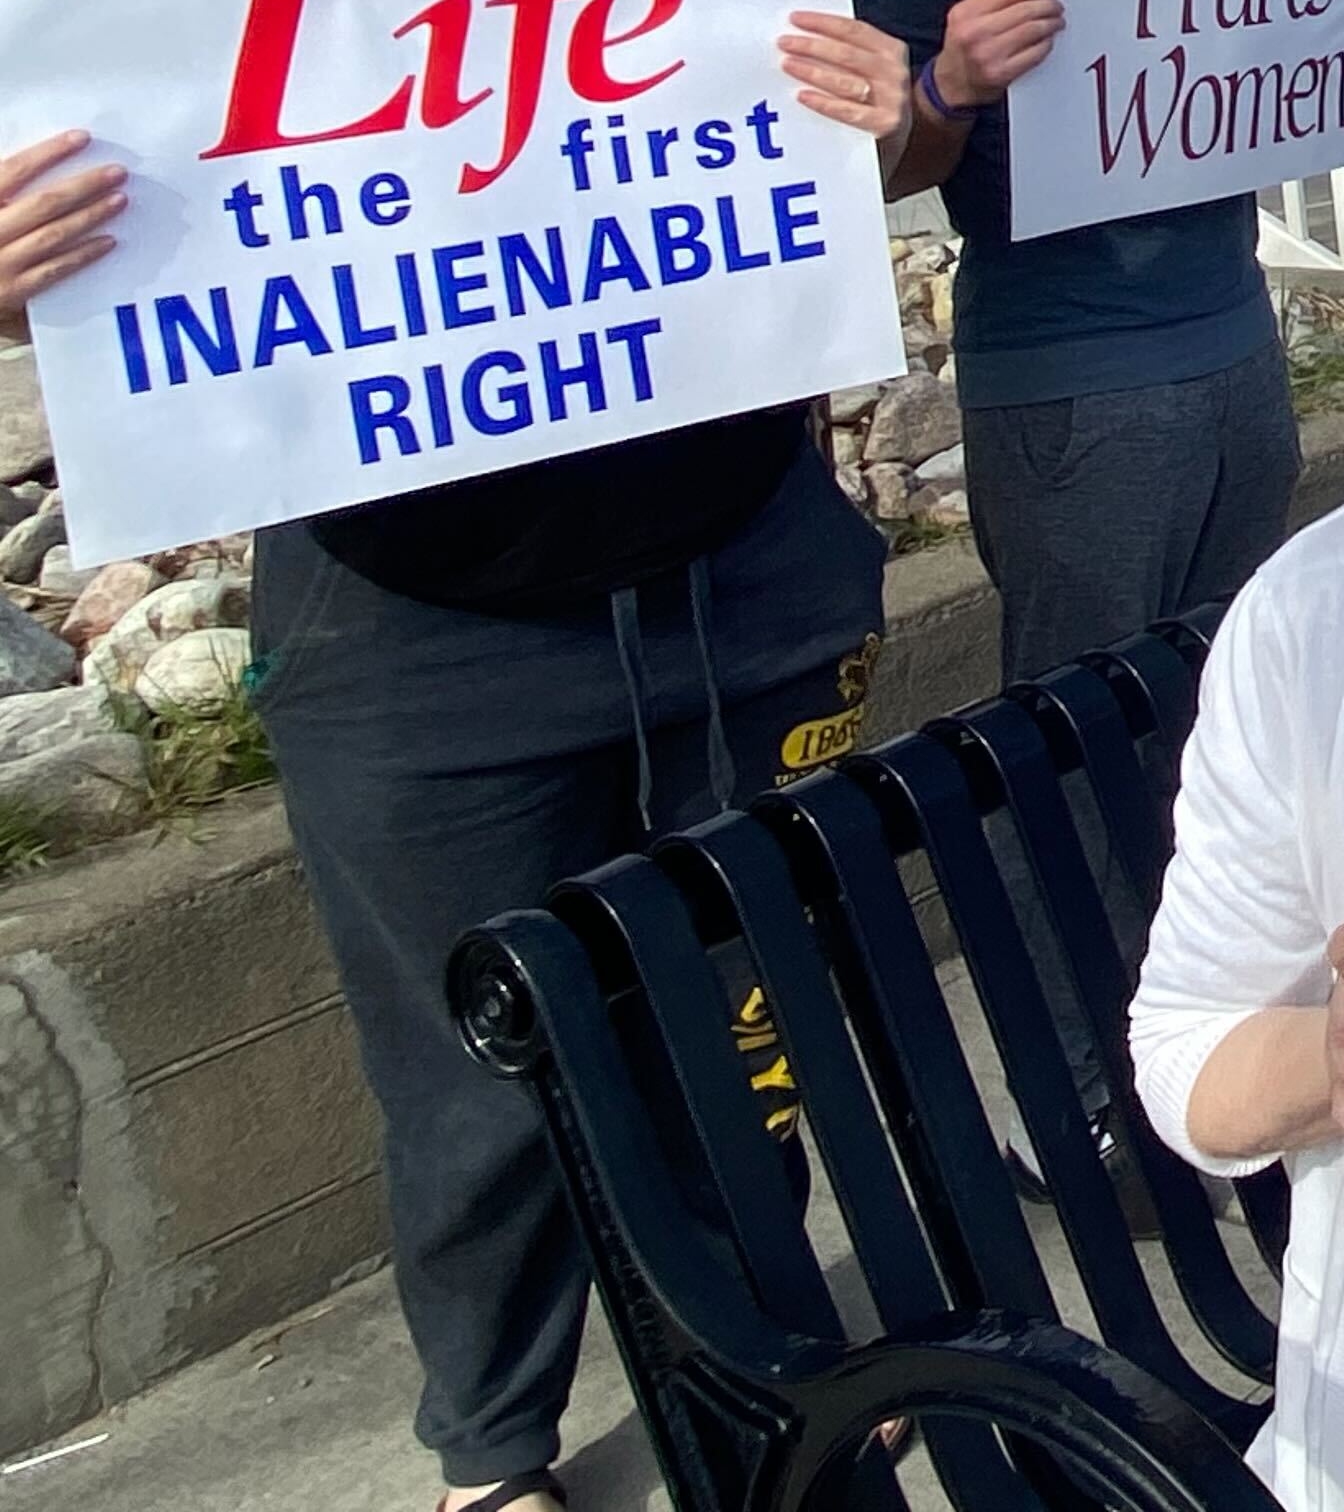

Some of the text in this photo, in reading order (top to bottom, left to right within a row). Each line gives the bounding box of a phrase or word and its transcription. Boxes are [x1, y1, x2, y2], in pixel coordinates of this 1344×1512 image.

[223, 98, 785, 249] the first
[114, 180, 827, 394] INALIENABLE
[348, 318, 663, 466] RIGHT
